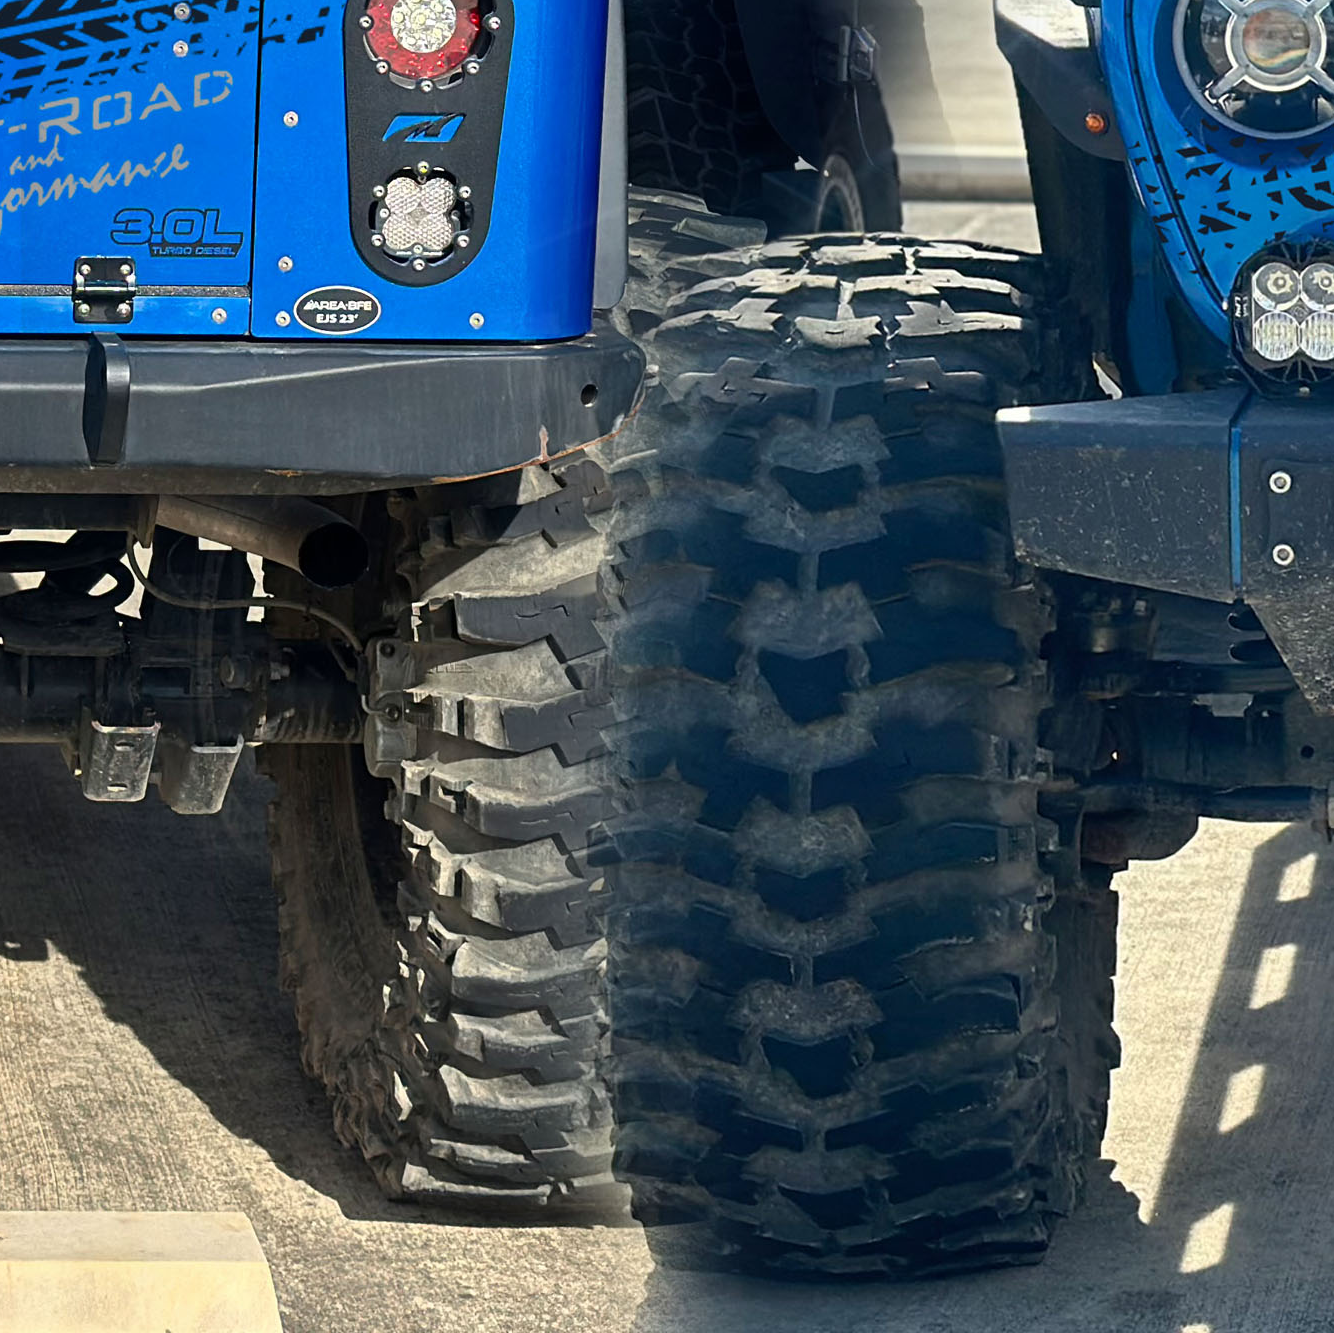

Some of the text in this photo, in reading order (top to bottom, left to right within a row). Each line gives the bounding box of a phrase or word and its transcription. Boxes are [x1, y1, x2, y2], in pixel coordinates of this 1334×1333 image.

[9, 134, 65, 176] and
[110, 208, 244, 245] 3.0L
[316, 313, 337, 323] EJS
